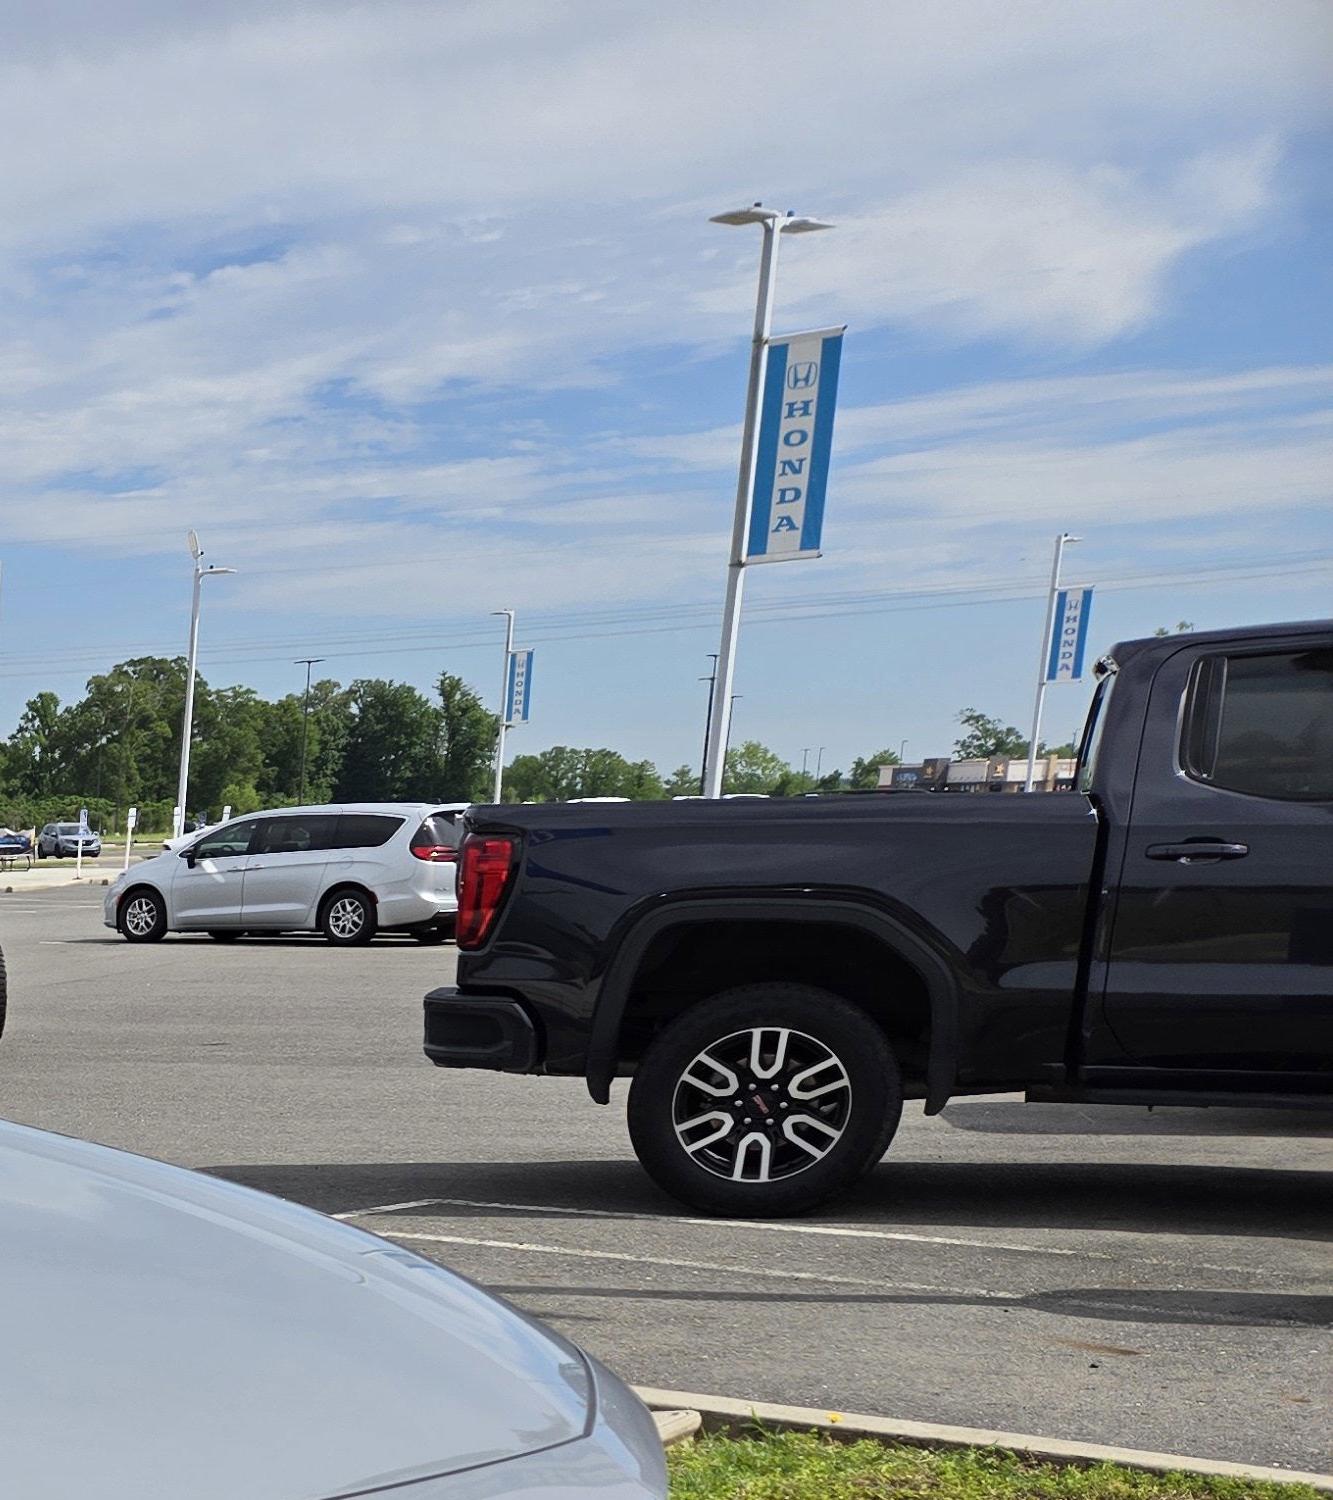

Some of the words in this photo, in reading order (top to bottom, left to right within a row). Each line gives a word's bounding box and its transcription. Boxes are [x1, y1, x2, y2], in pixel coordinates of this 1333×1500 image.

[771, 399, 815, 533] HONDA
[1058, 616, 1079, 672] HONDA
[513, 671, 525, 715] HONDA
